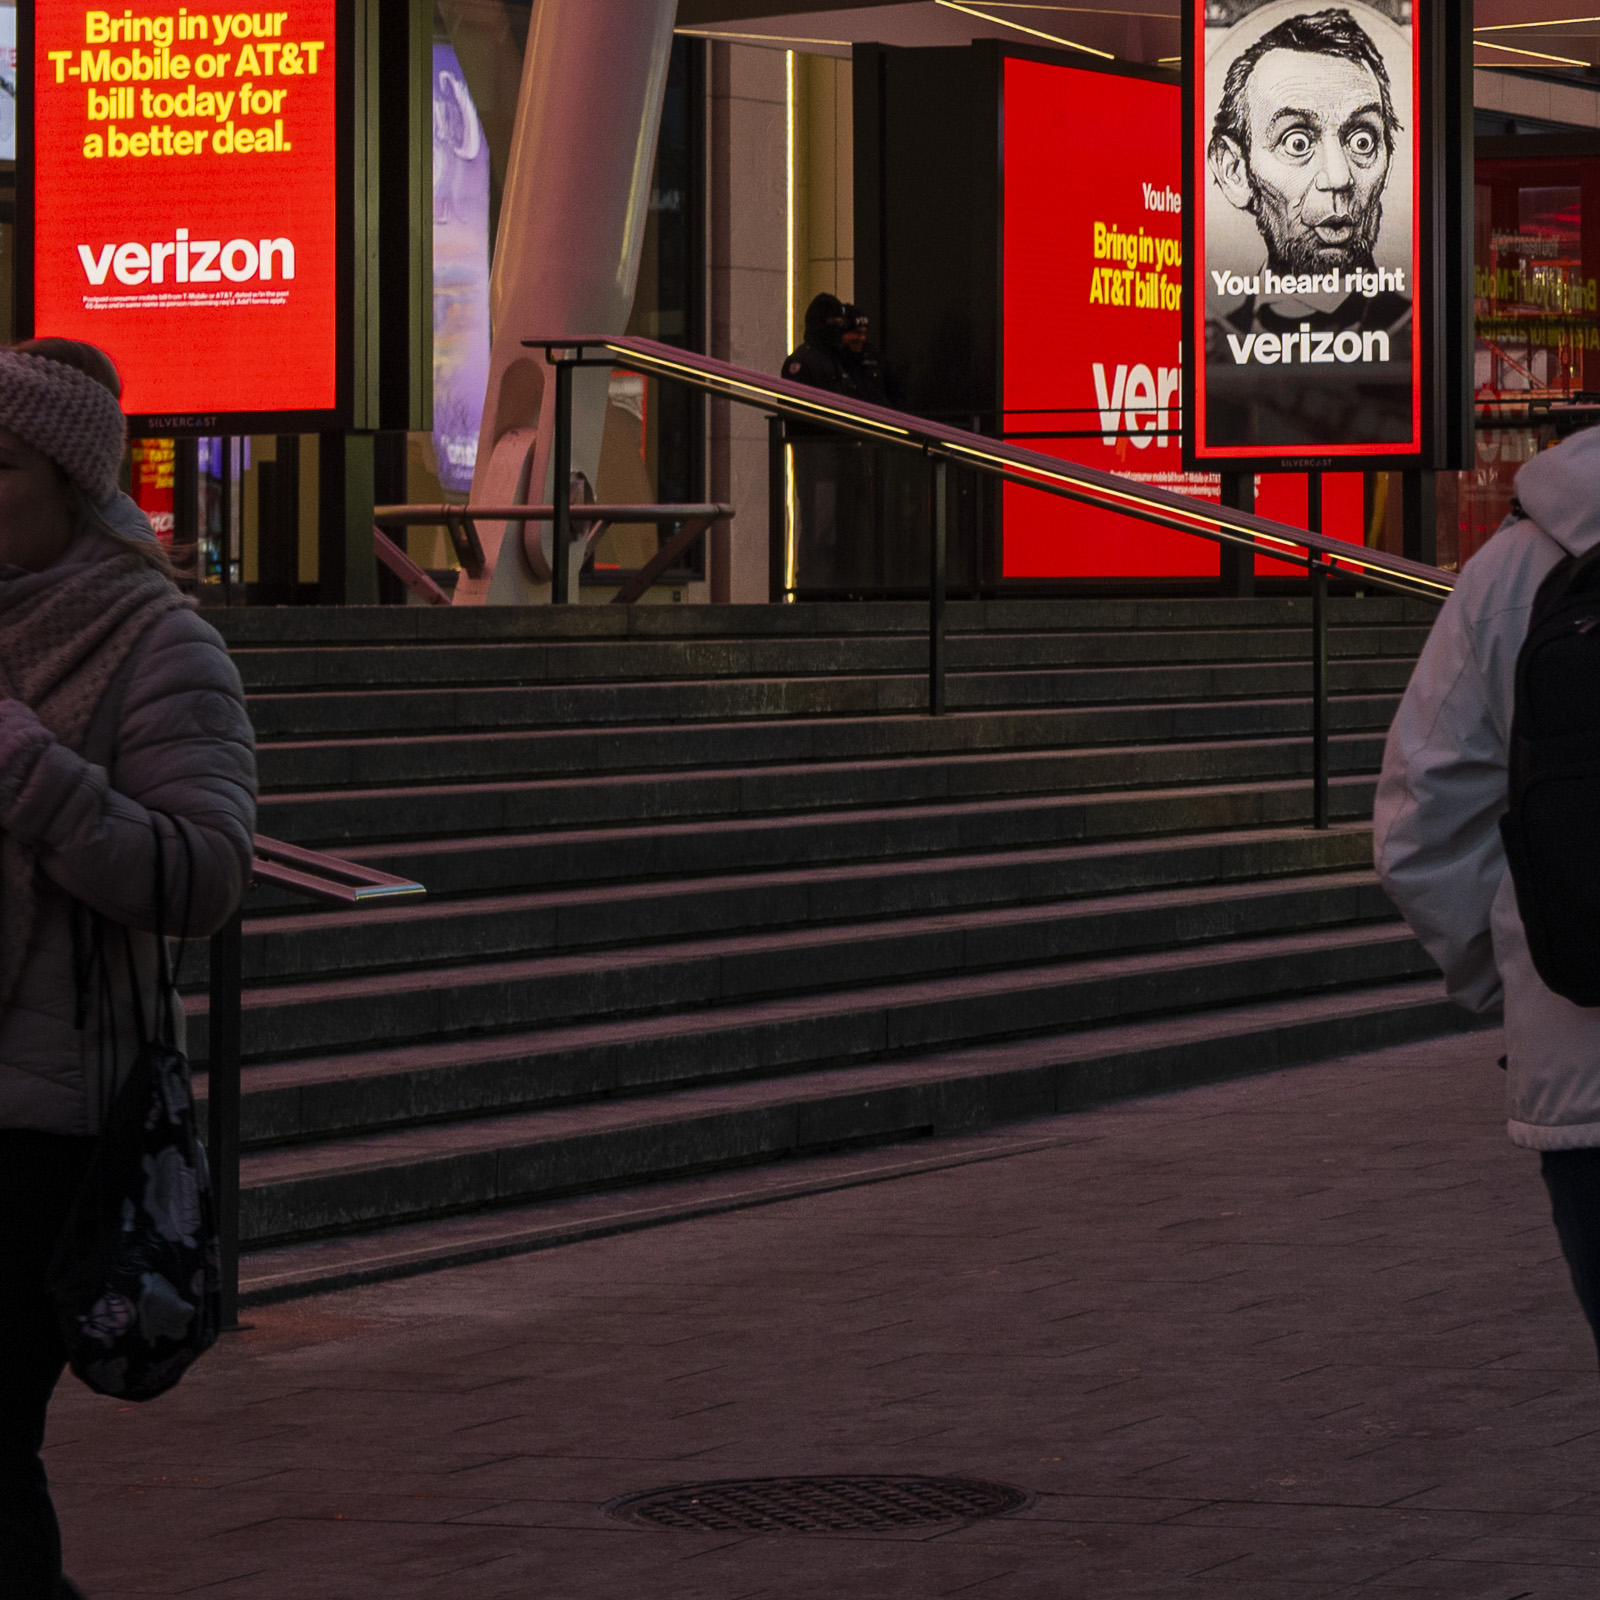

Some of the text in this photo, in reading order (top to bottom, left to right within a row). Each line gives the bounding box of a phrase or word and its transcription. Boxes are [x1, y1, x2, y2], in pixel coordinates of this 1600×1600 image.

[85, 7, 288, 48] Bring in your
[48, 46, 191, 84] T-Mobile
[194, 52, 232, 79] or
[234, 41, 325, 78] AT&T
[87, 82, 288, 123] bill today for
[82, 118, 292, 160] a better deal.
[1142, 182, 1165, 212] You
[77, 227, 296, 286] verizon
[1093, 221, 1137, 270] Bring
[1138, 226, 1154, 261] in
[1089, 266, 1134, 308] AT&T
[1135, 271, 1159, 310] bill
[1211, 266, 1406, 298] You heard right
[1226, 322, 1391, 365] verizon
